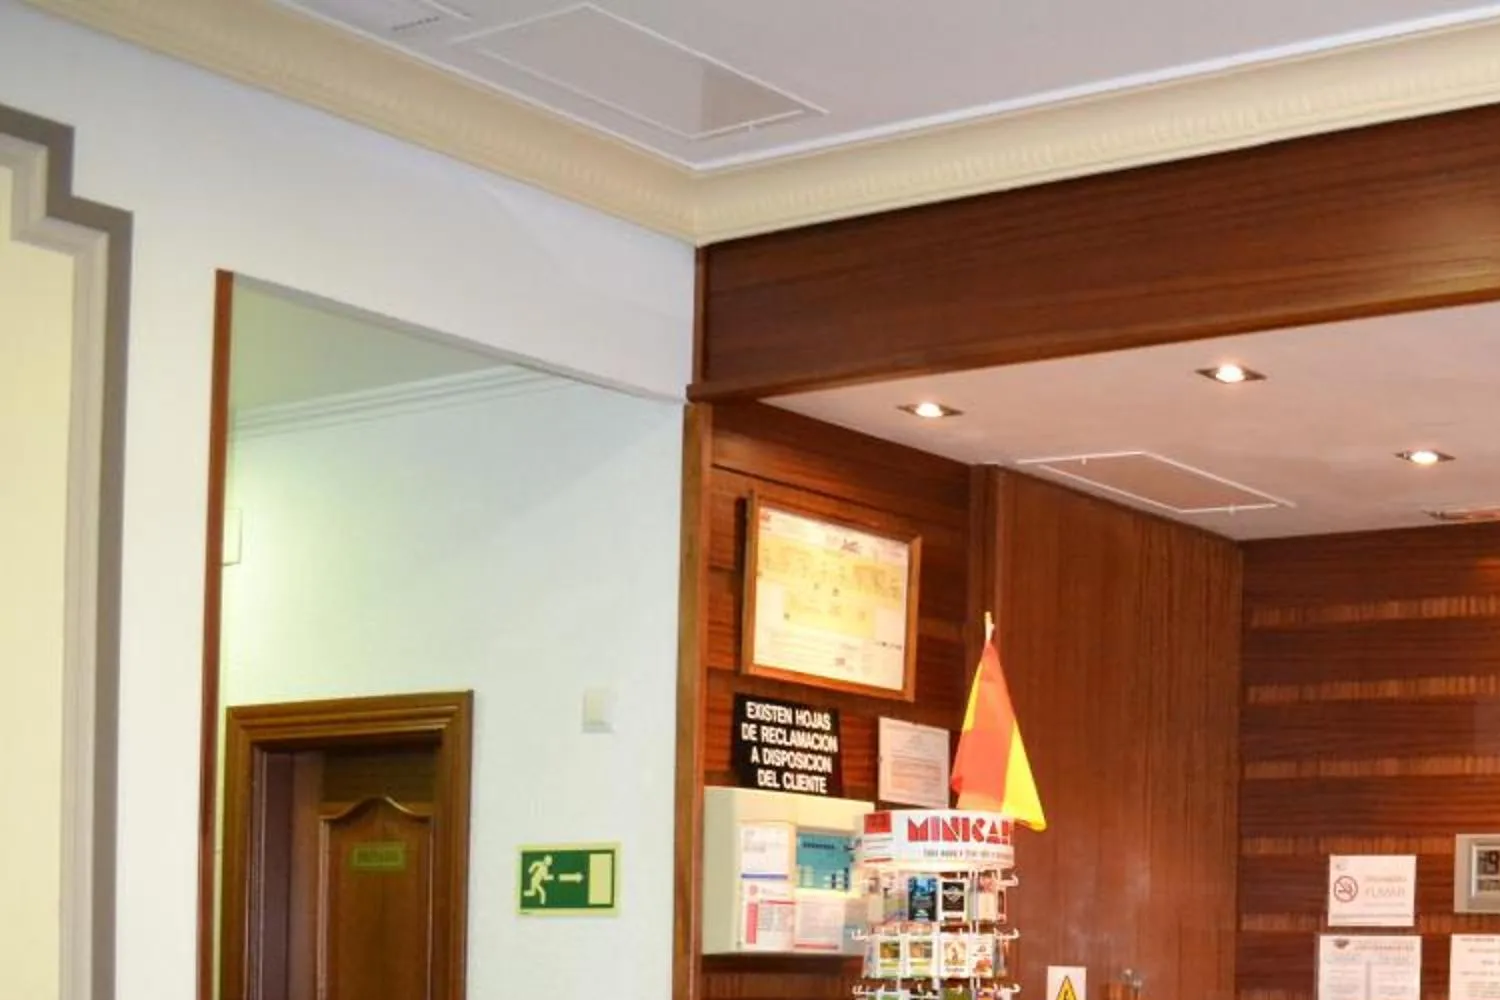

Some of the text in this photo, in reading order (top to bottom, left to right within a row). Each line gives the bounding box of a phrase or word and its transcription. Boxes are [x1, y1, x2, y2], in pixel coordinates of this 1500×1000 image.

[745, 701, 831, 731] EXISTEN HOJAS
[741, 722, 838, 752] DE RECLAMACION
[751, 746, 833, 773] A DISPOSICION
[757, 768, 828, 794] DEL CLIENTE
